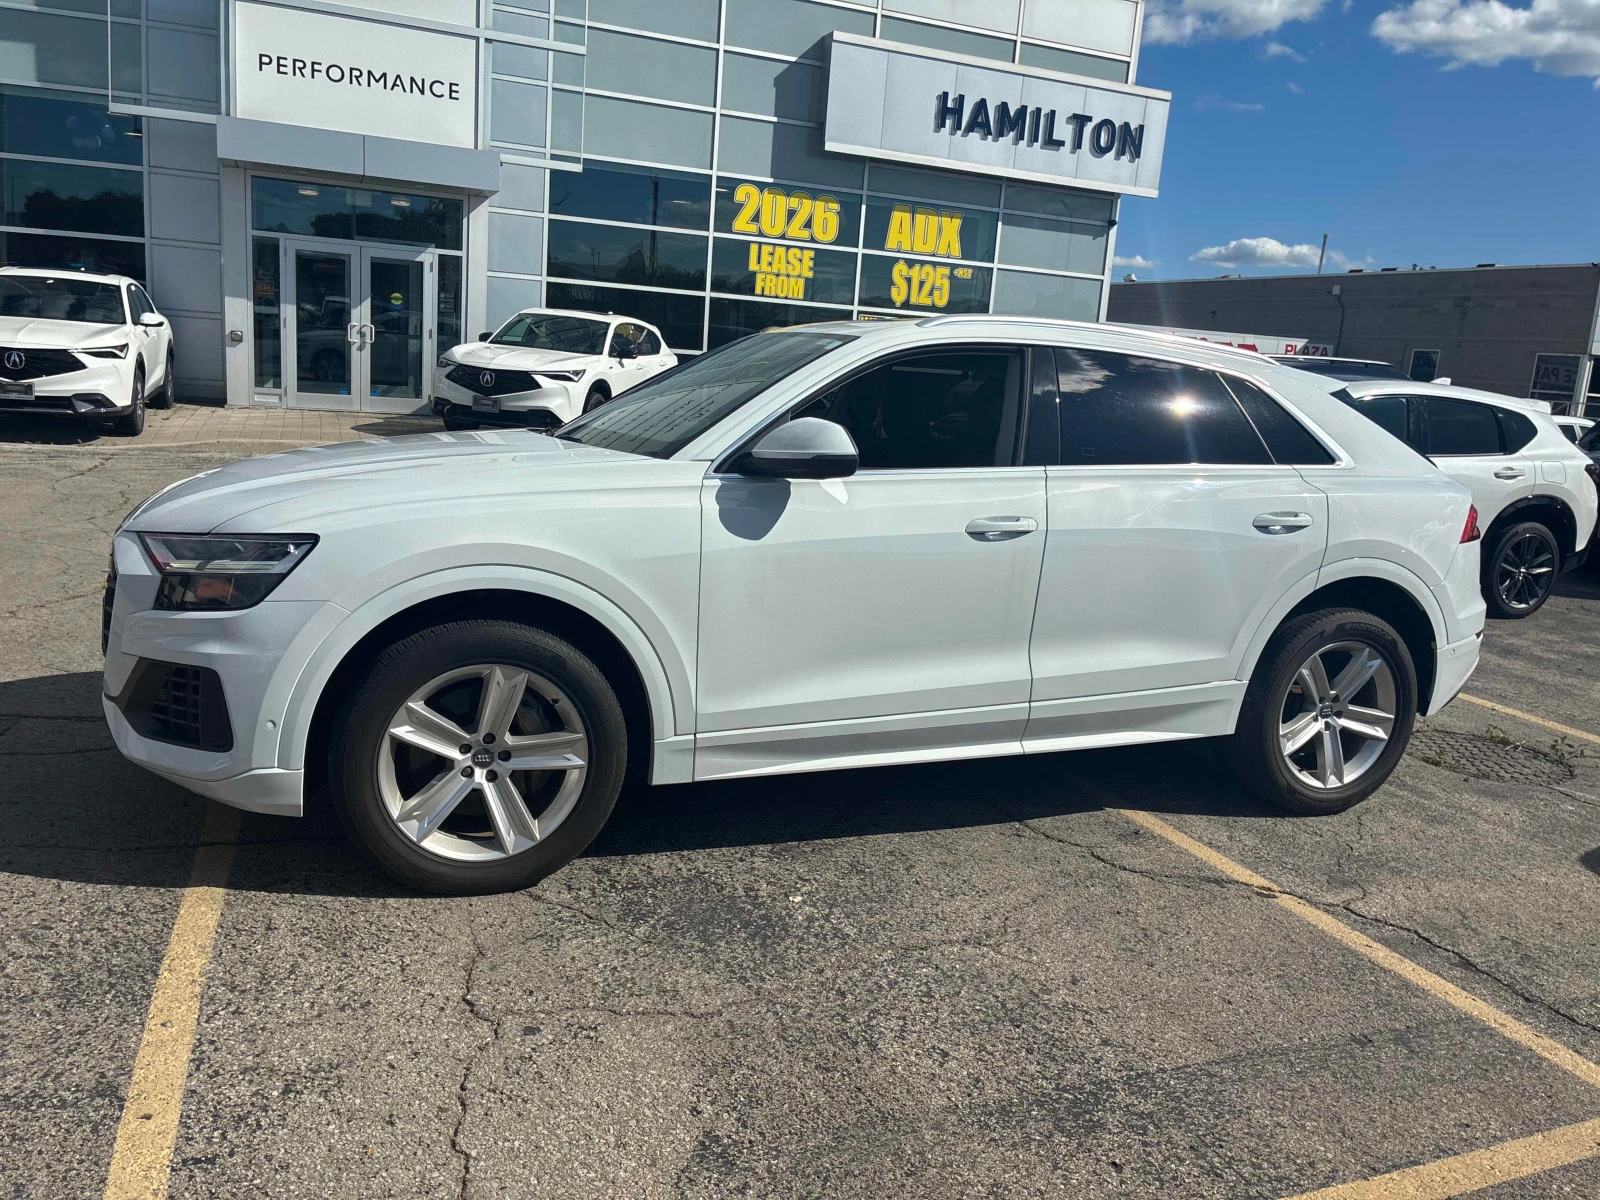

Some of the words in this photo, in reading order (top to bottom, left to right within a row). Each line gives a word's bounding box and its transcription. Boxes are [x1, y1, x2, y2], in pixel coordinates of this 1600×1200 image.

[258, 53, 460, 101] PERFORMANCE
[936, 91, 1145, 162] HAMILTON
[732, 183, 840, 243] 2026
[885, 203, 964, 258] ADX
[748, 243, 814, 279] LEASE
[890, 259, 950, 307] $125
[755, 272, 805, 300] FROM
[1285, 344, 1329, 357] PLAZA
